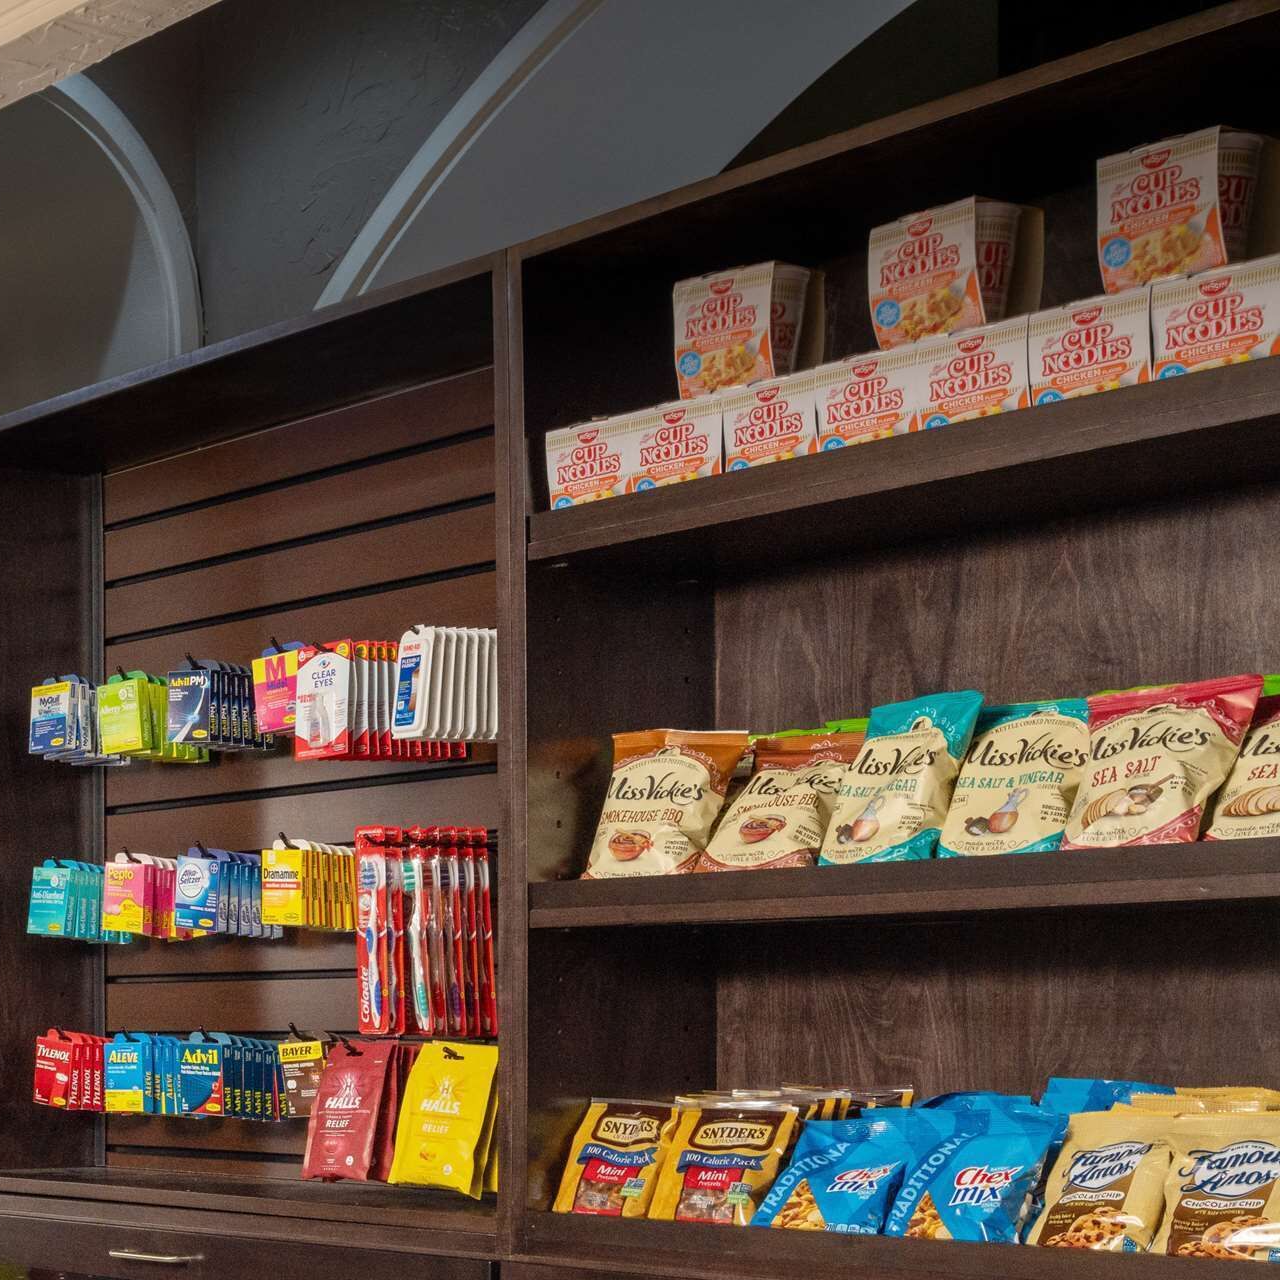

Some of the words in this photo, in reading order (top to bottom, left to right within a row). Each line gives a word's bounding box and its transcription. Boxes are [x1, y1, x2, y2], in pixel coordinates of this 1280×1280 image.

[1130, 166, 1181, 195] CUP
[1110, 178, 1201, 224] NOODLES
[897, 233, 943, 261] CUP
[879, 244, 960, 287] NOODLES
[701, 293, 743, 319] CUP
[1187, 294, 1244, 325] CUP
[684, 305, 757, 340] NOODLES
[1165, 308, 1264, 350] NOODLES
[1061, 323, 1113, 352] CUP
[1041, 336, 1133, 377] NOODLES
[1179, 339, 1230, 359] CHICKEN
[947, 351, 996, 379] CUP
[929, 363, 1012, 402] NOODLES
[1056, 368, 1102, 385] CHICKEN
[843, 376, 888, 401] CUP
[827, 389, 904, 424] NOODLES
[942, 393, 985, 411] CHICKEN
[748, 401, 789, 425] CUP
[655, 424, 694, 447] CUP
[734, 413, 803, 447] NOODLES
[839, 417, 878, 433] CHICKEN
[570, 443, 608, 465] CUP
[640, 435, 709, 466] NOODLES
[744, 441, 781, 456] CHICKEN
[557, 454, 622, 486] NOODLES
[649, 461, 686, 475] CHICKEN
[564, 479, 601, 494] CHICKEN
[265, 656, 288, 681] M
[311, 668, 336, 680] CLEAR
[169, 677, 190, 687] Advil
[190, 675, 205, 686] PM
[314, 678, 334, 688] EYES
[1128, 719, 1211, 754] Vickie's
[1016, 732, 1089, 769] Vickie's
[956, 775, 979, 789] SEA
[981, 775, 1006, 788] SALT
[1017, 770, 1065, 786] VINEGAR
[1091, 766, 1118, 788] SEA
[1124, 755, 1162, 779] SALT
[1247, 764, 1279, 781] SEA
[643, 771, 705, 806] Vickie's
[600, 808, 659, 826] SMOKEHOUSE
[660, 807, 684, 826] BBQ
[107, 866, 134, 882] Pepto
[263, 866, 299, 881] Dramamine
[360, 964, 371, 1023] Colgate
[37, 1043, 71, 1062] TYLENOL
[108, 1050, 139, 1064] ALEVE
[181, 1048, 219, 1065] Advil
[281, 1045, 313, 1057] BAYER
[69, 1069, 79, 1106] TYLENOL
[82, 1068, 91, 1106] TYLENOL
[92, 1069, 101, 1107] TYLENOL
[325, 1096, 362, 1109] HALLS
[420, 1097, 461, 1115] HALLS
[325, 1119, 350, 1128] RELIEF
[421, 1123, 450, 1135] RELIEF
[700, 1126, 768, 1140] SNYDER'S
[586, 1146, 601, 1155] 100
[602, 1149, 632, 1165] Calorie
[632, 1152, 651, 1165] Pack
[685, 1152, 701, 1162] 100
[702, 1155, 730, 1166] Calorie
[731, 1156, 758, 1168] Pack
[1178, 1150, 1280, 1178] Famou
[597, 1164, 626, 1177] Mini
[698, 1170, 728, 1181] Mini
[757, 1140, 852, 1216] TRADITIONA
[836, 1164, 892, 1182] Chex
[955, 1166, 1018, 1187] Chex
[1180, 1170, 1276, 1193] Amos
[1099, 1192, 1123, 1200] CHIP
[1185, 1199, 1238, 1209] CHOCOLATE
[1238, 1199, 1262, 1208] CHIP
